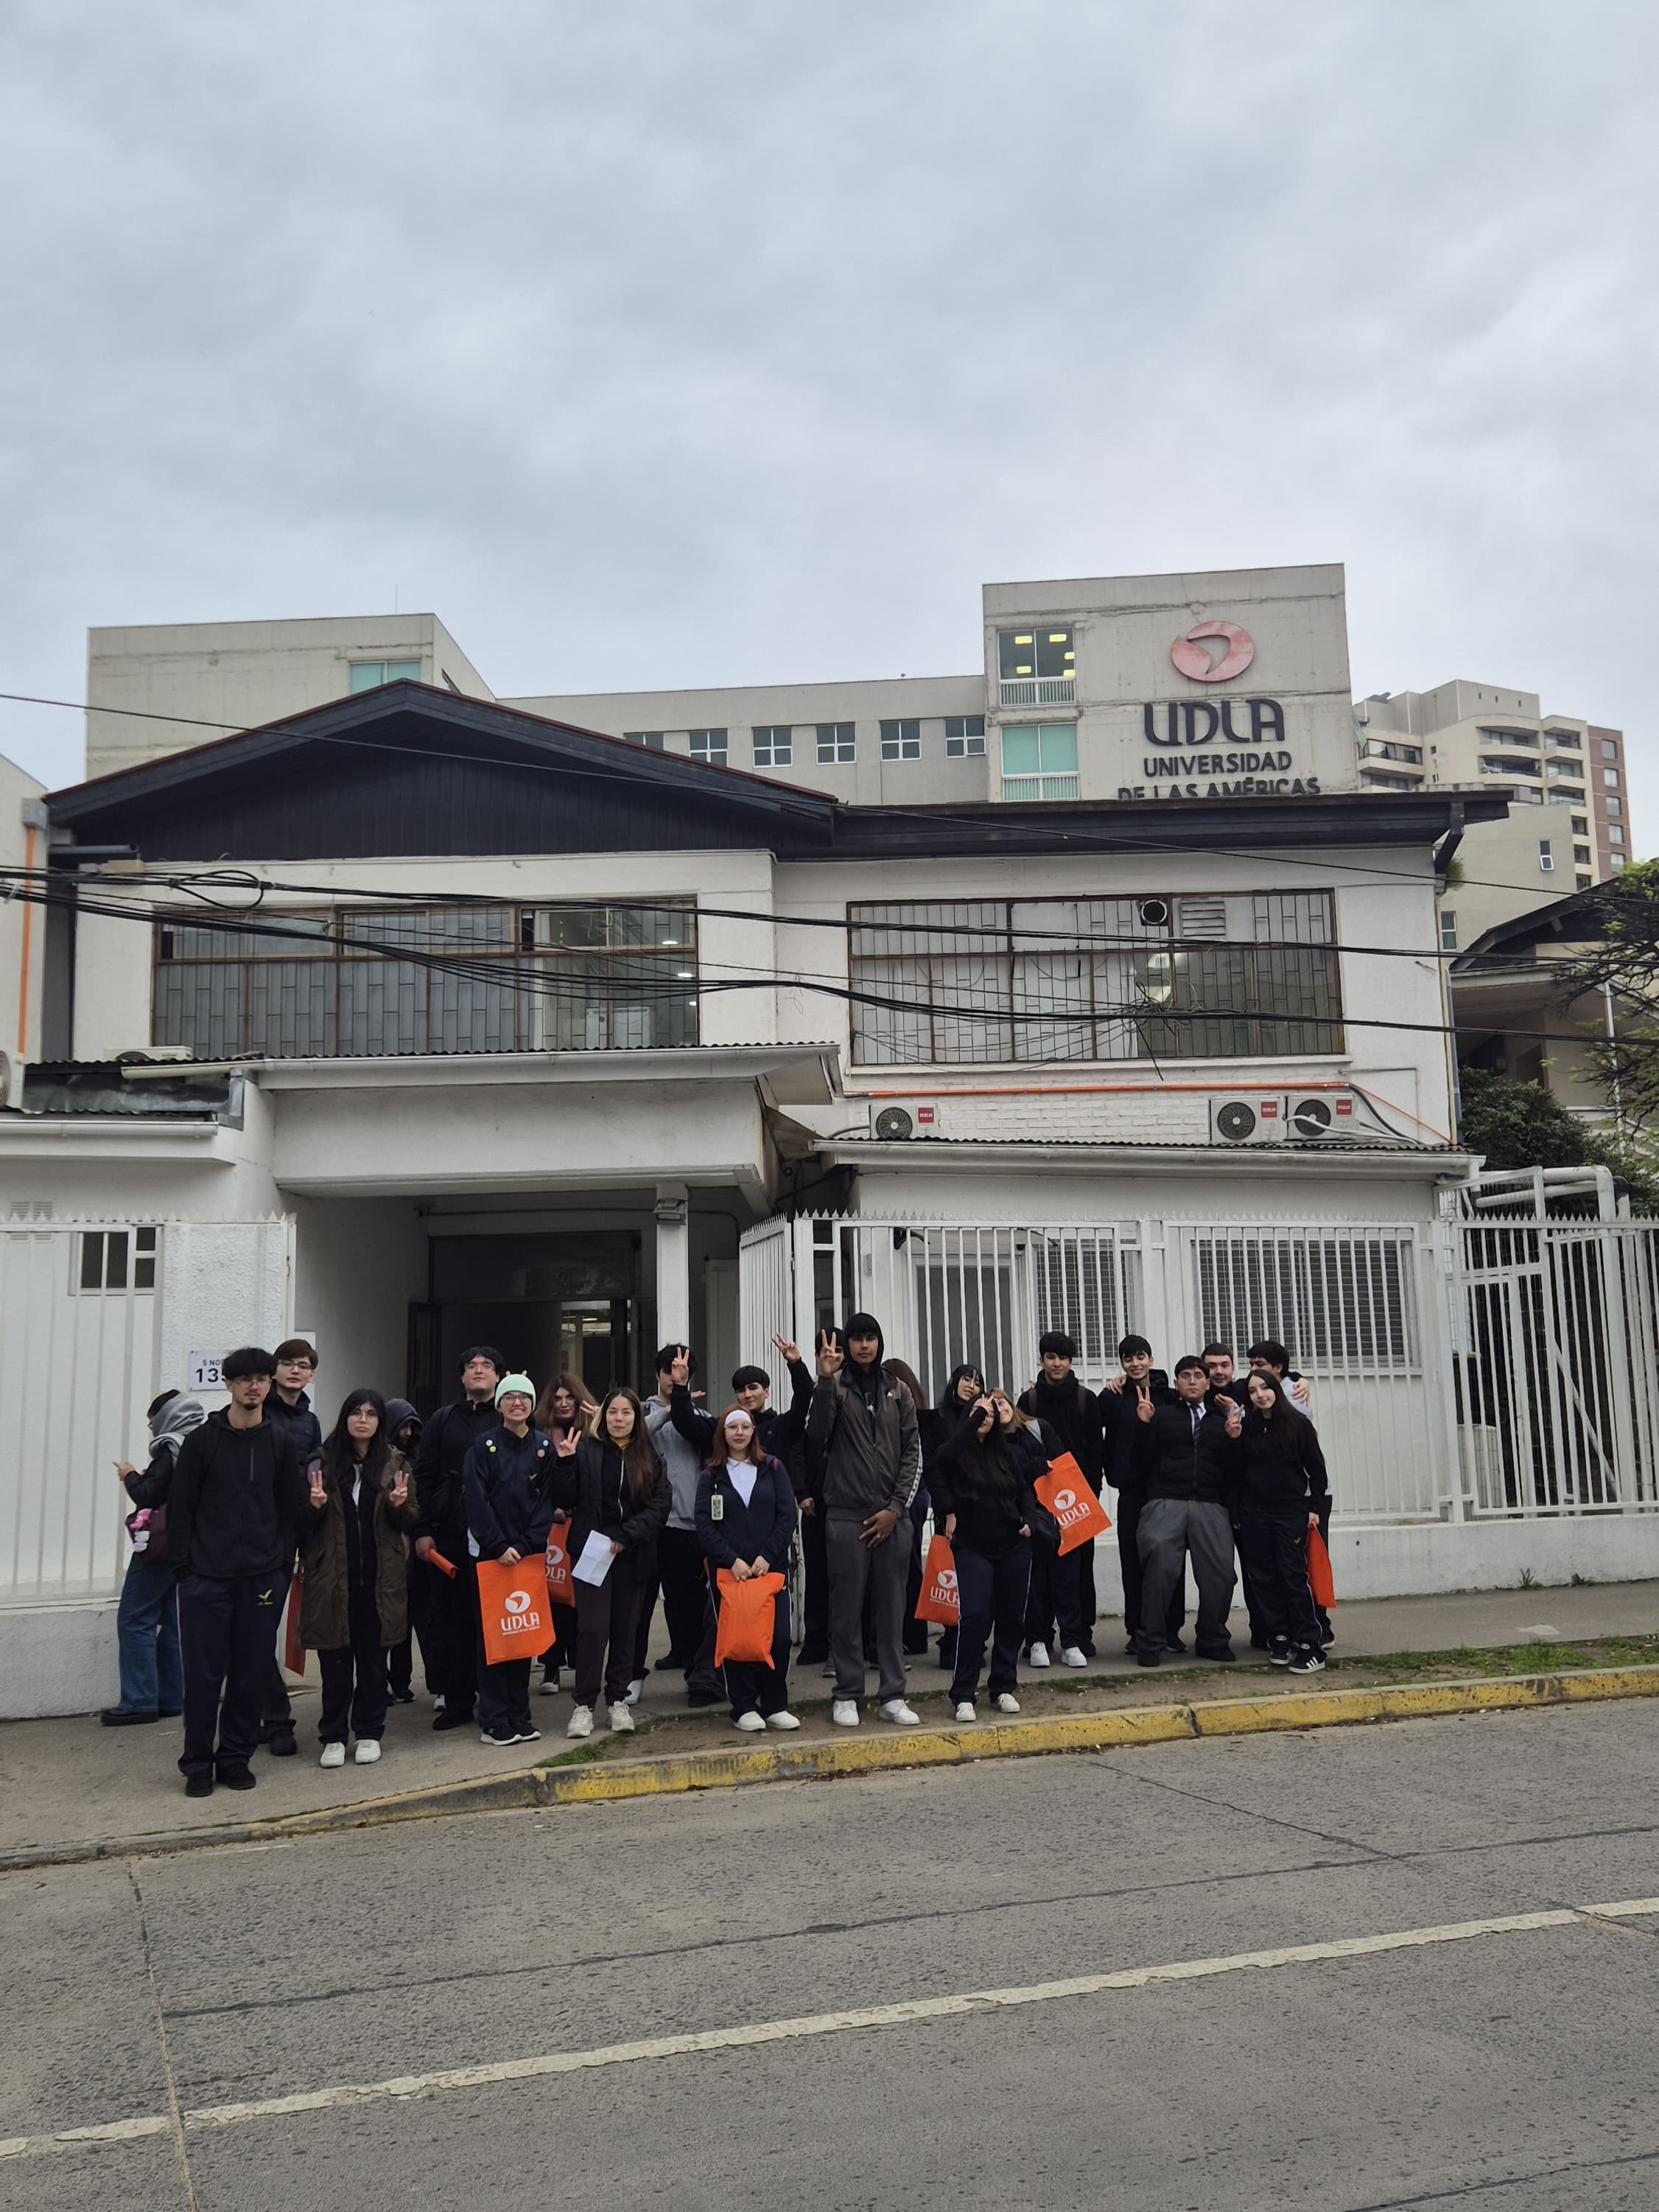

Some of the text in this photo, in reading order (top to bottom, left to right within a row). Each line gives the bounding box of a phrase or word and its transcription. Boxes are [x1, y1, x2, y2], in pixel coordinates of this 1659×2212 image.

[1144, 699, 1285, 746] UDLA
[1144, 751, 1291, 777] UNIVERSIDAD
[195, 1368, 225, 1383] 13
[1056, 1502, 1090, 1525] UDLA
[500, 1612, 540, 1631] UDLA
